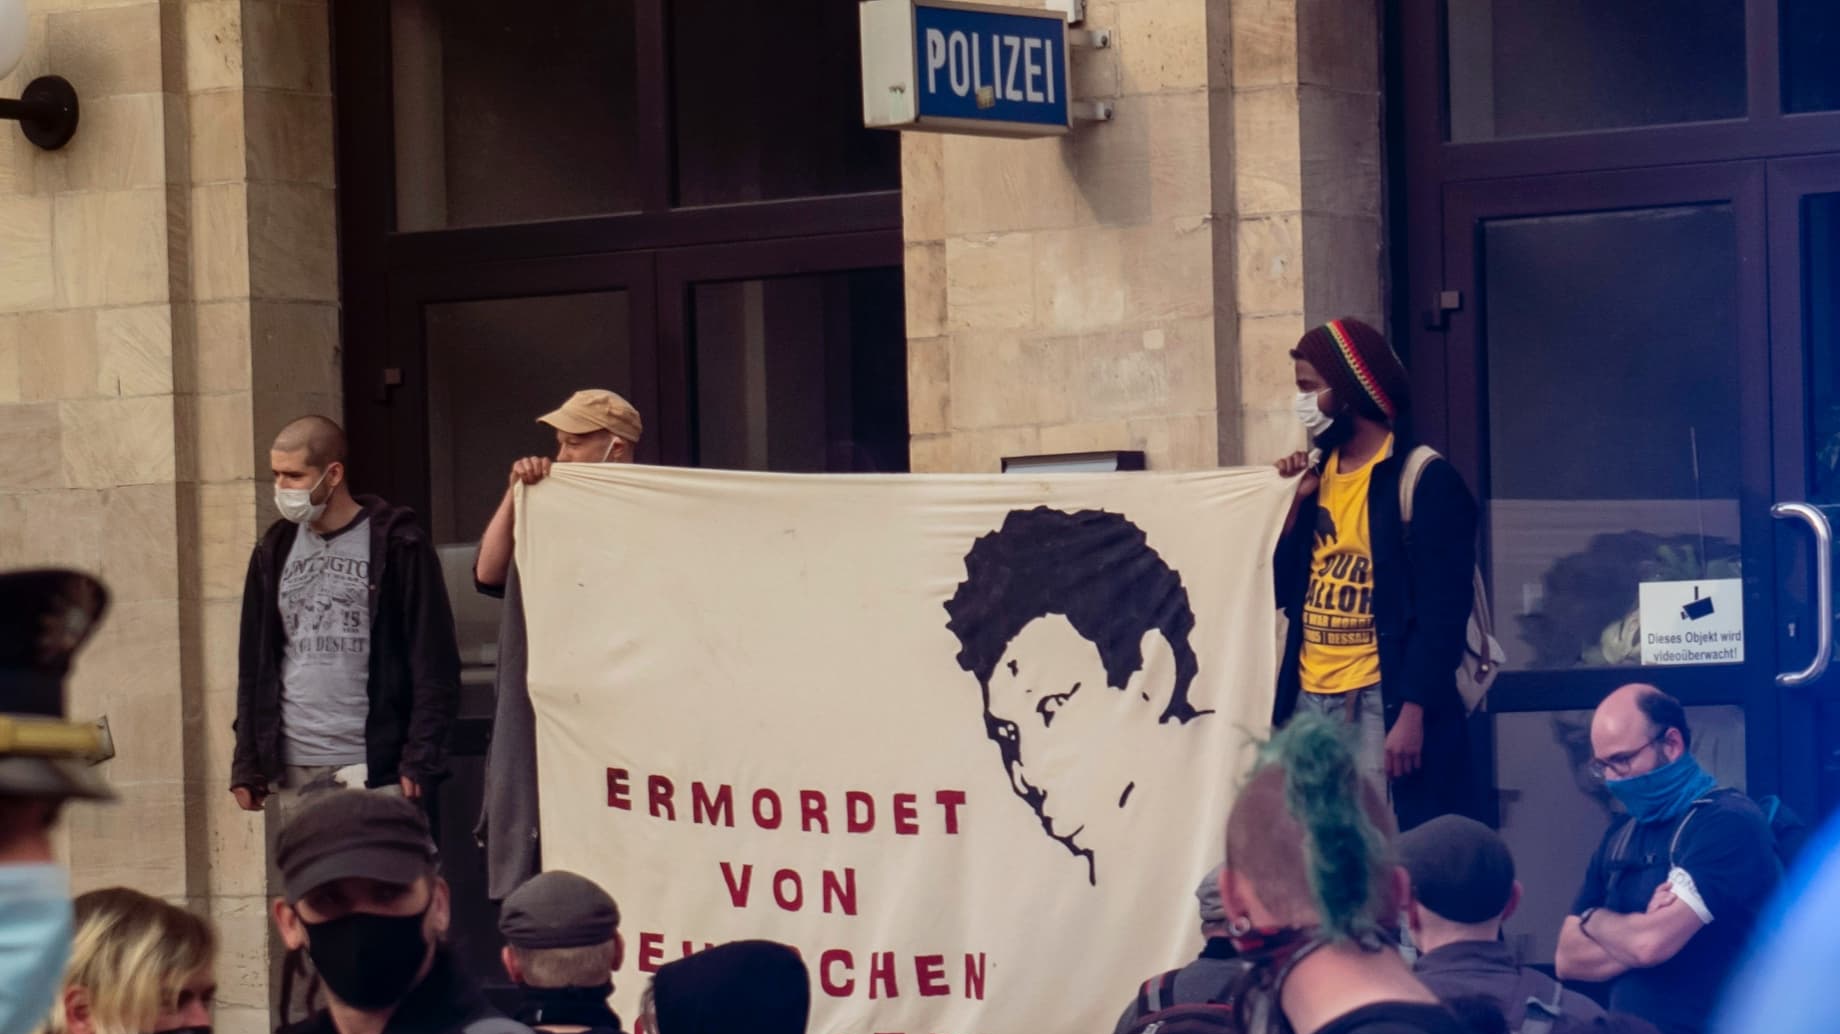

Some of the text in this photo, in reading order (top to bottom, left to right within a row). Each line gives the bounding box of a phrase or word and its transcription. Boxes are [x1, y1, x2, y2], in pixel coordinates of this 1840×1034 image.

[925, 28, 1056, 104] POLIZEI
[1647, 629, 1742, 646] Dieses Objekt wird
[1652, 647, 1738, 662] videoüberwacht!
[606, 766, 967, 836] ERMORDET
[719, 861, 859, 916] VON
